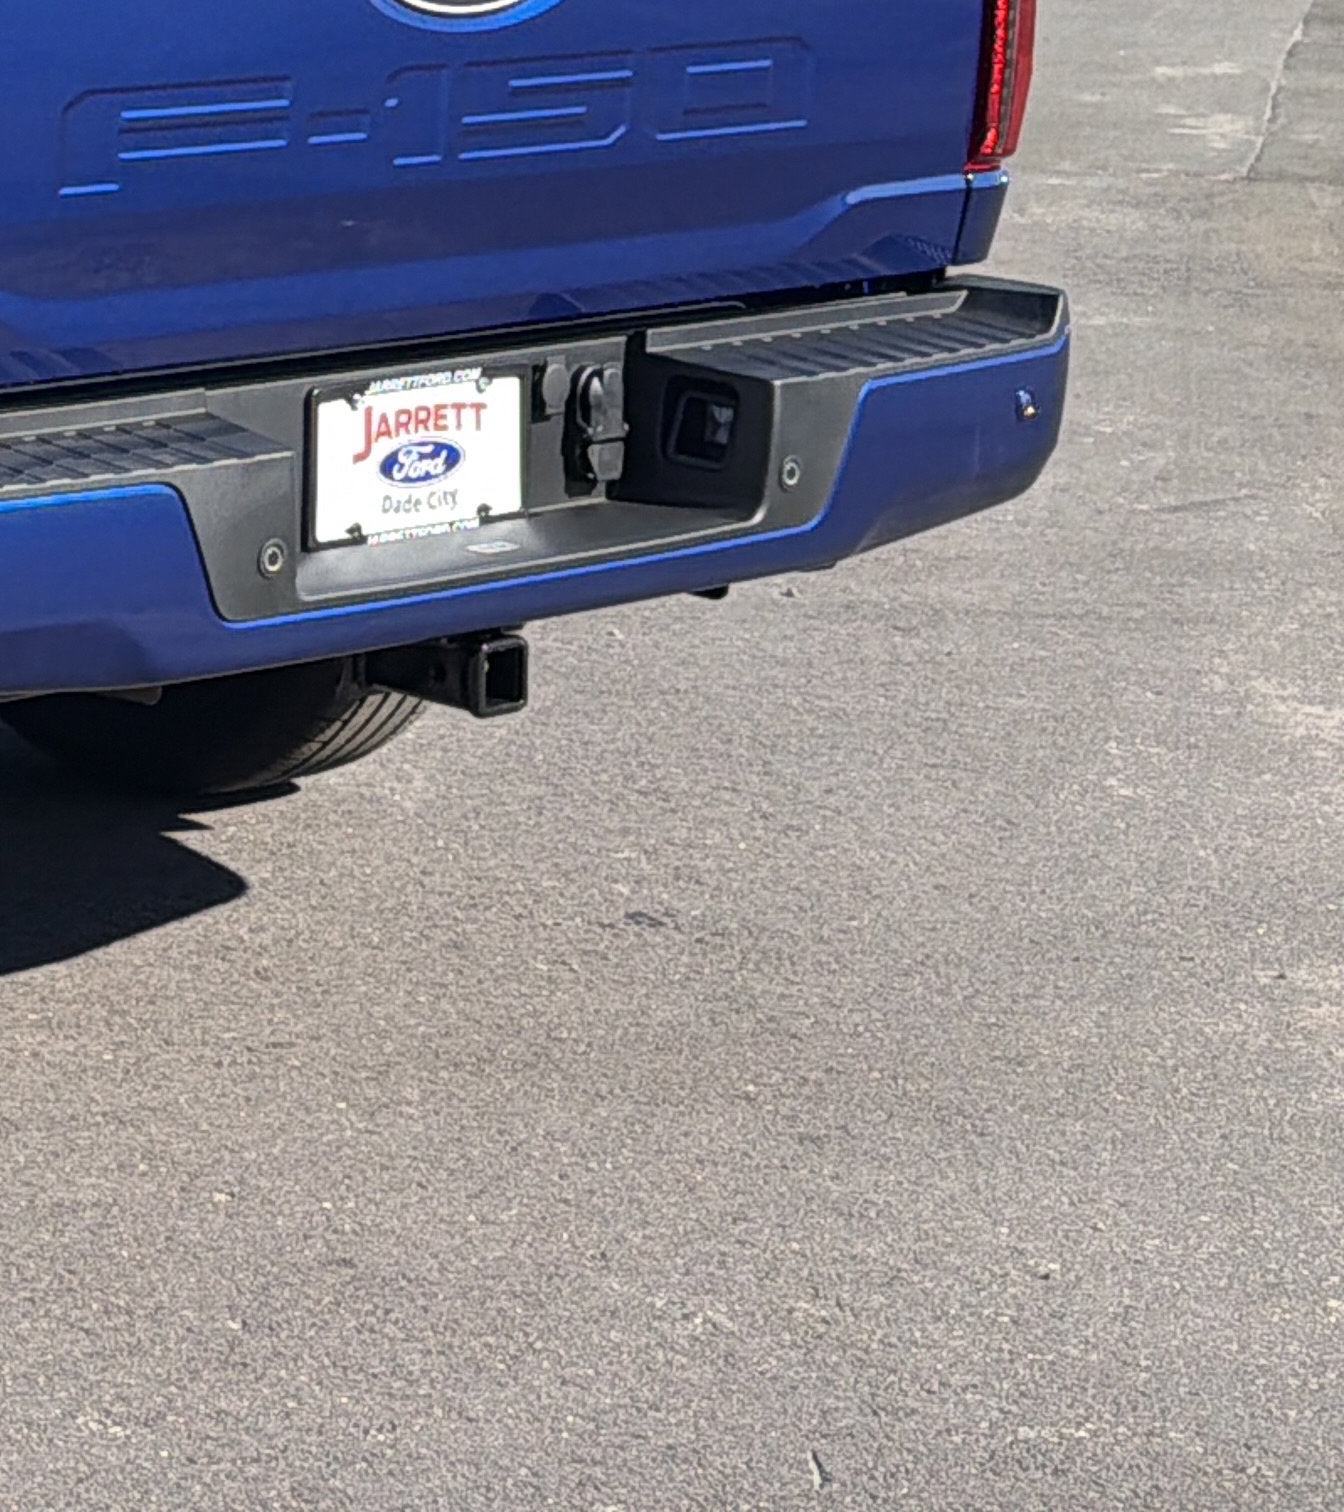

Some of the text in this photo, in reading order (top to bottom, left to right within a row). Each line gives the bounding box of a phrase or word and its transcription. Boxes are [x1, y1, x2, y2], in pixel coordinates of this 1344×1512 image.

[59, 36, 815, 198] F-150
[352, 402, 488, 465] JARRETT
[381, 488, 459, 515] Dade City
